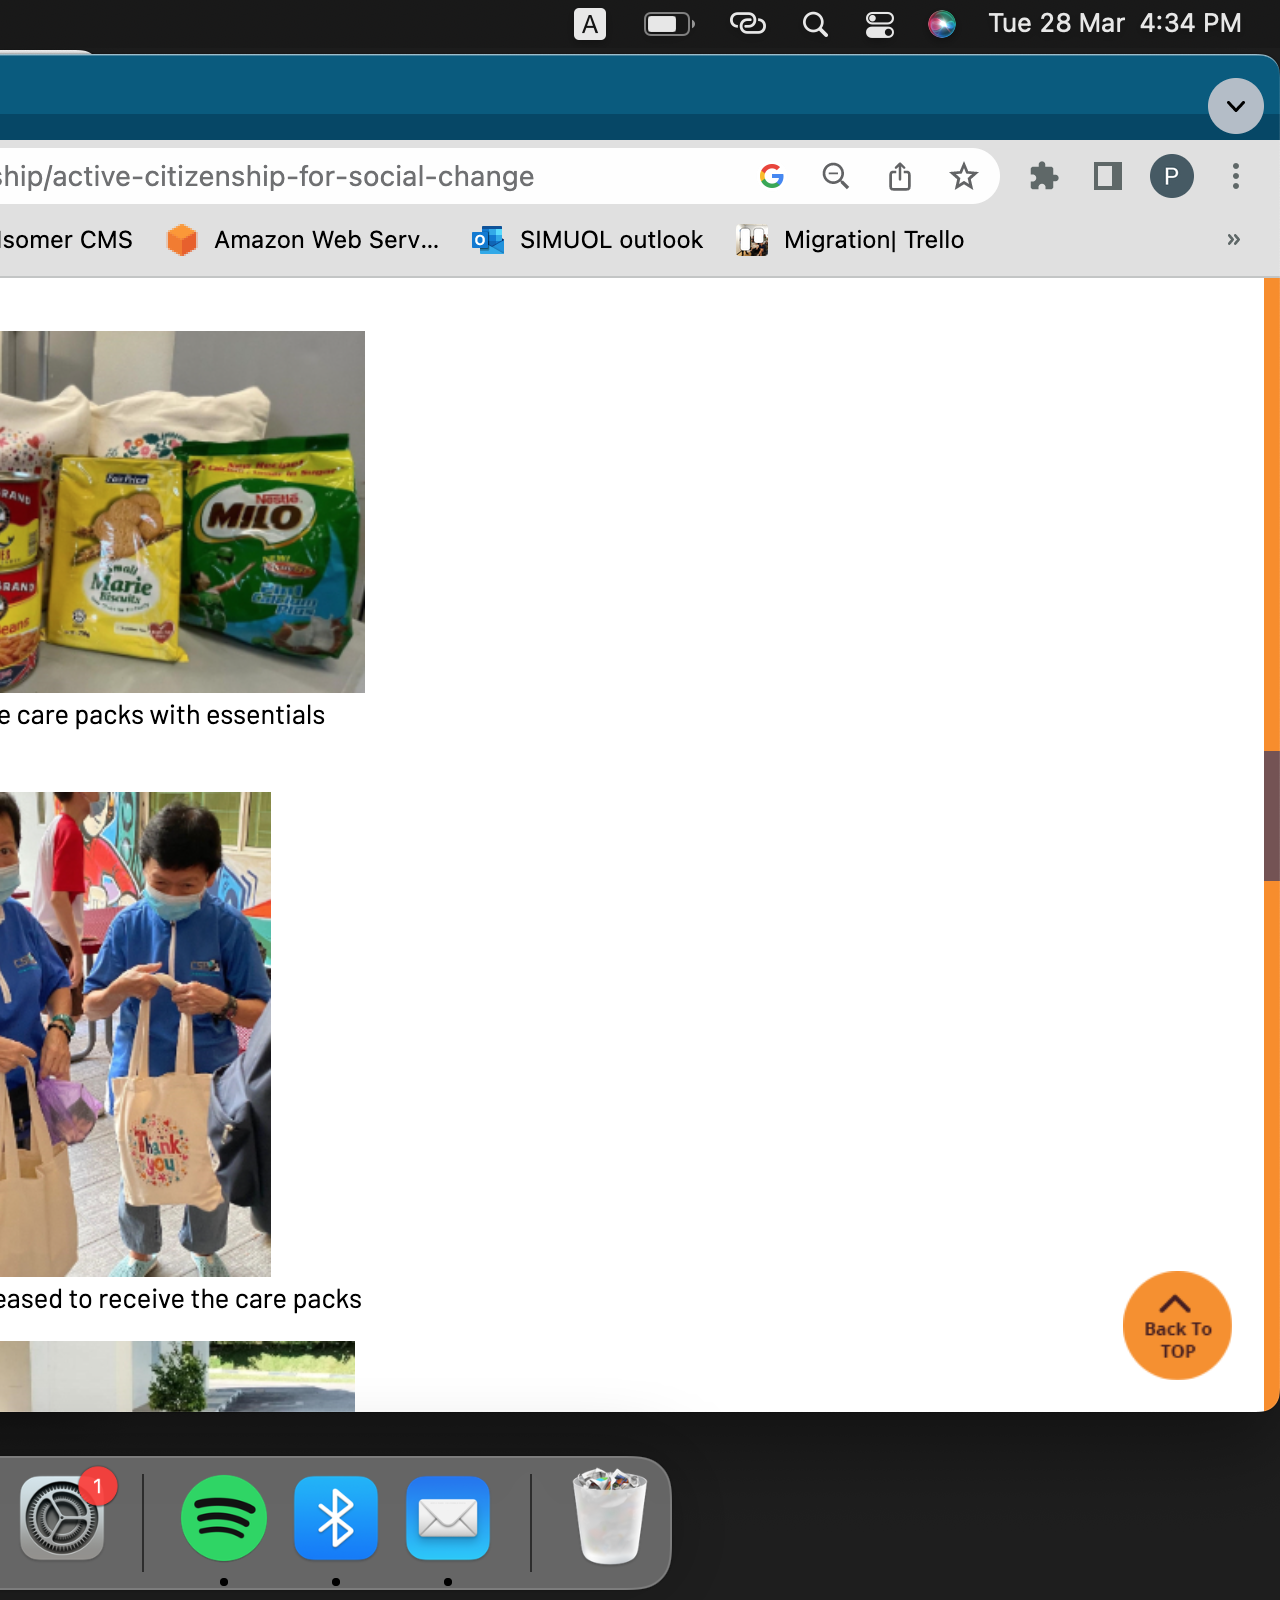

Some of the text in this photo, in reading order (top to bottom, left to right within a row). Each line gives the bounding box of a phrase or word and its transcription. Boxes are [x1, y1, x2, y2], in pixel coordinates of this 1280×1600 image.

[988, 11, 1241, 33] Tue 28 Mar 4:34 PM
[80, 229, 133, 250] CMS
[214, 229, 439, 250] Amazon Web Serv...
[520, 229, 704, 250] SIMUOL outlook
[903, 229, 965, 249] Trello
[206, 502, 303, 531] MILO
[90, 573, 153, 596] Marie
[99, 591, 141, 605] Biscuits
[251, 591, 318, 608] Calcium
[275, 603, 317, 617] Plus
[17, 708, 69, 725] care
[75, 703, 144, 731] packs
[149, 703, 200, 725] with
[206, 703, 325, 725] essentials
[134, 1130, 182, 1156] Thank
[145, 1156, 175, 1177] you
[68, 1289, 92, 1309] to
[99, 1287, 185, 1309] receive
[190, 1287, 229, 1309] the
[235, 1292, 287, 1309] care
[293, 1287, 362, 1315] packs
[1144, 1321, 1213, 1336] Back To
[1160, 1344, 1196, 1359] TOP
